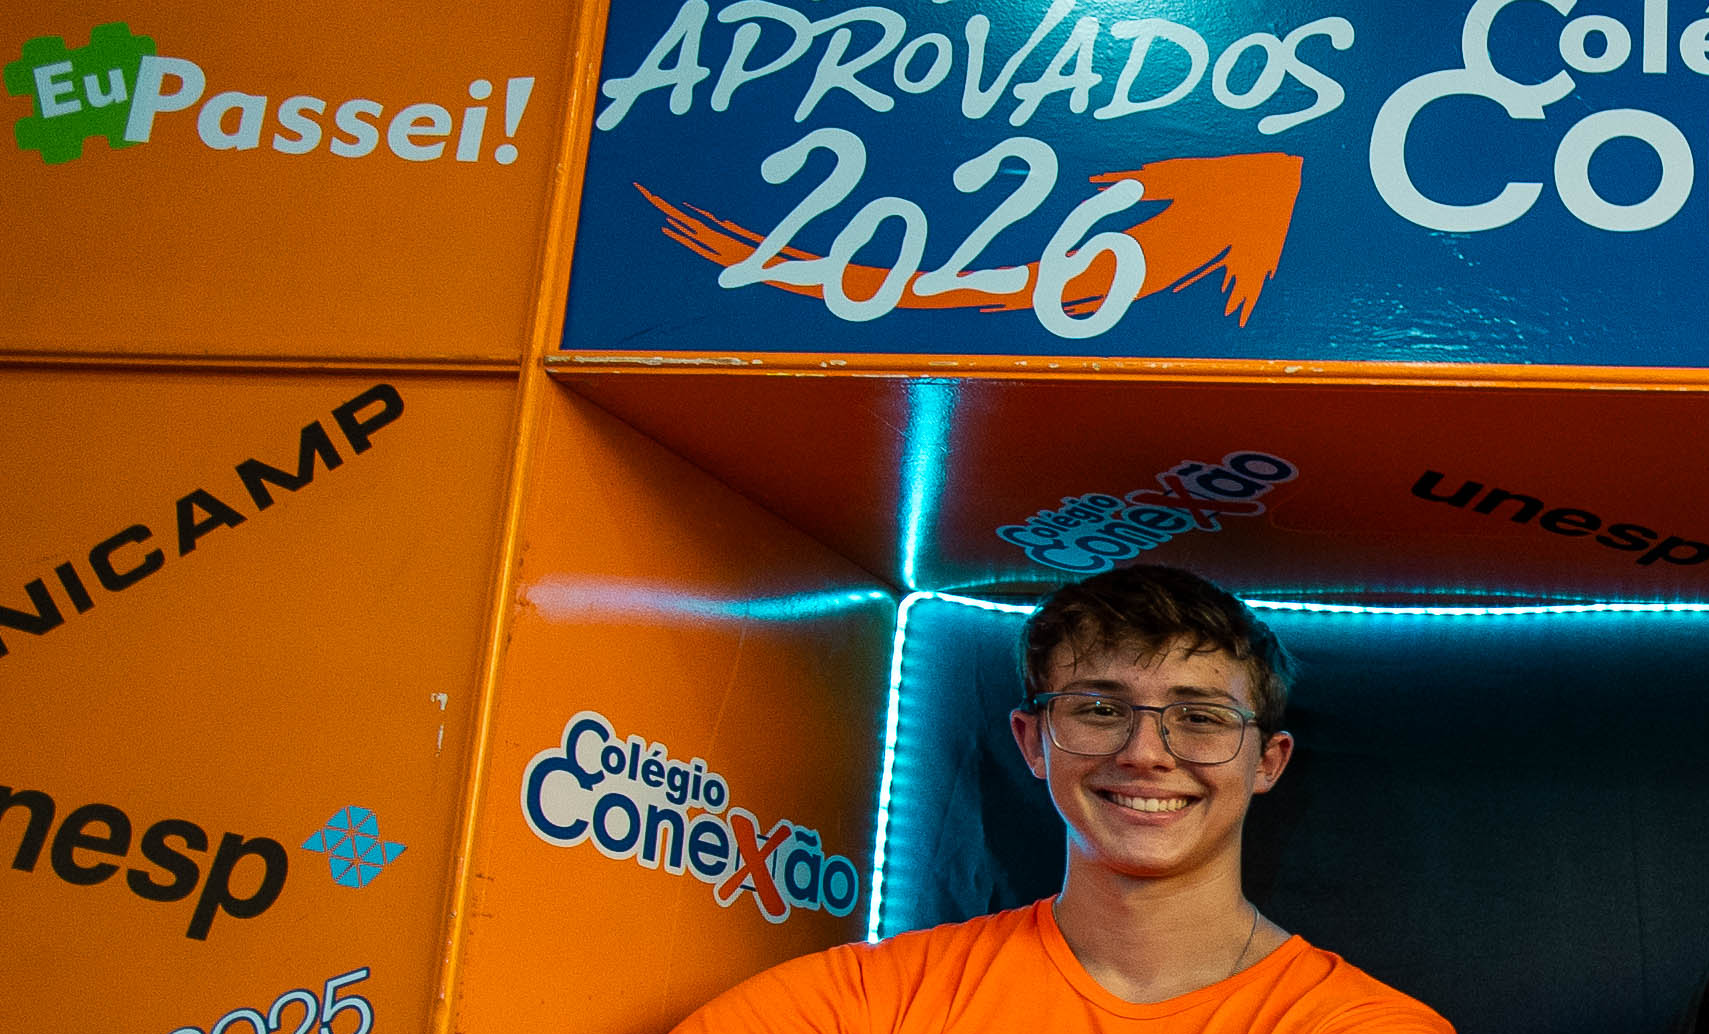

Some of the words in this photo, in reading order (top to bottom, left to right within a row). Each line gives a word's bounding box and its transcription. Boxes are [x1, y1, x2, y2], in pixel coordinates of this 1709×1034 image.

[33, 60, 128, 119] Eu
[123, 55, 535, 165] Passei!
[595, 0, 1355, 134] APROVADOS
[718, 127, 1147, 339] 2026
[0, 383, 405, 658] NICAMP
[1002, 492, 1122, 548] Colégio
[566, 718, 726, 807] Colégio
[0, 785, 289, 941] nesp
